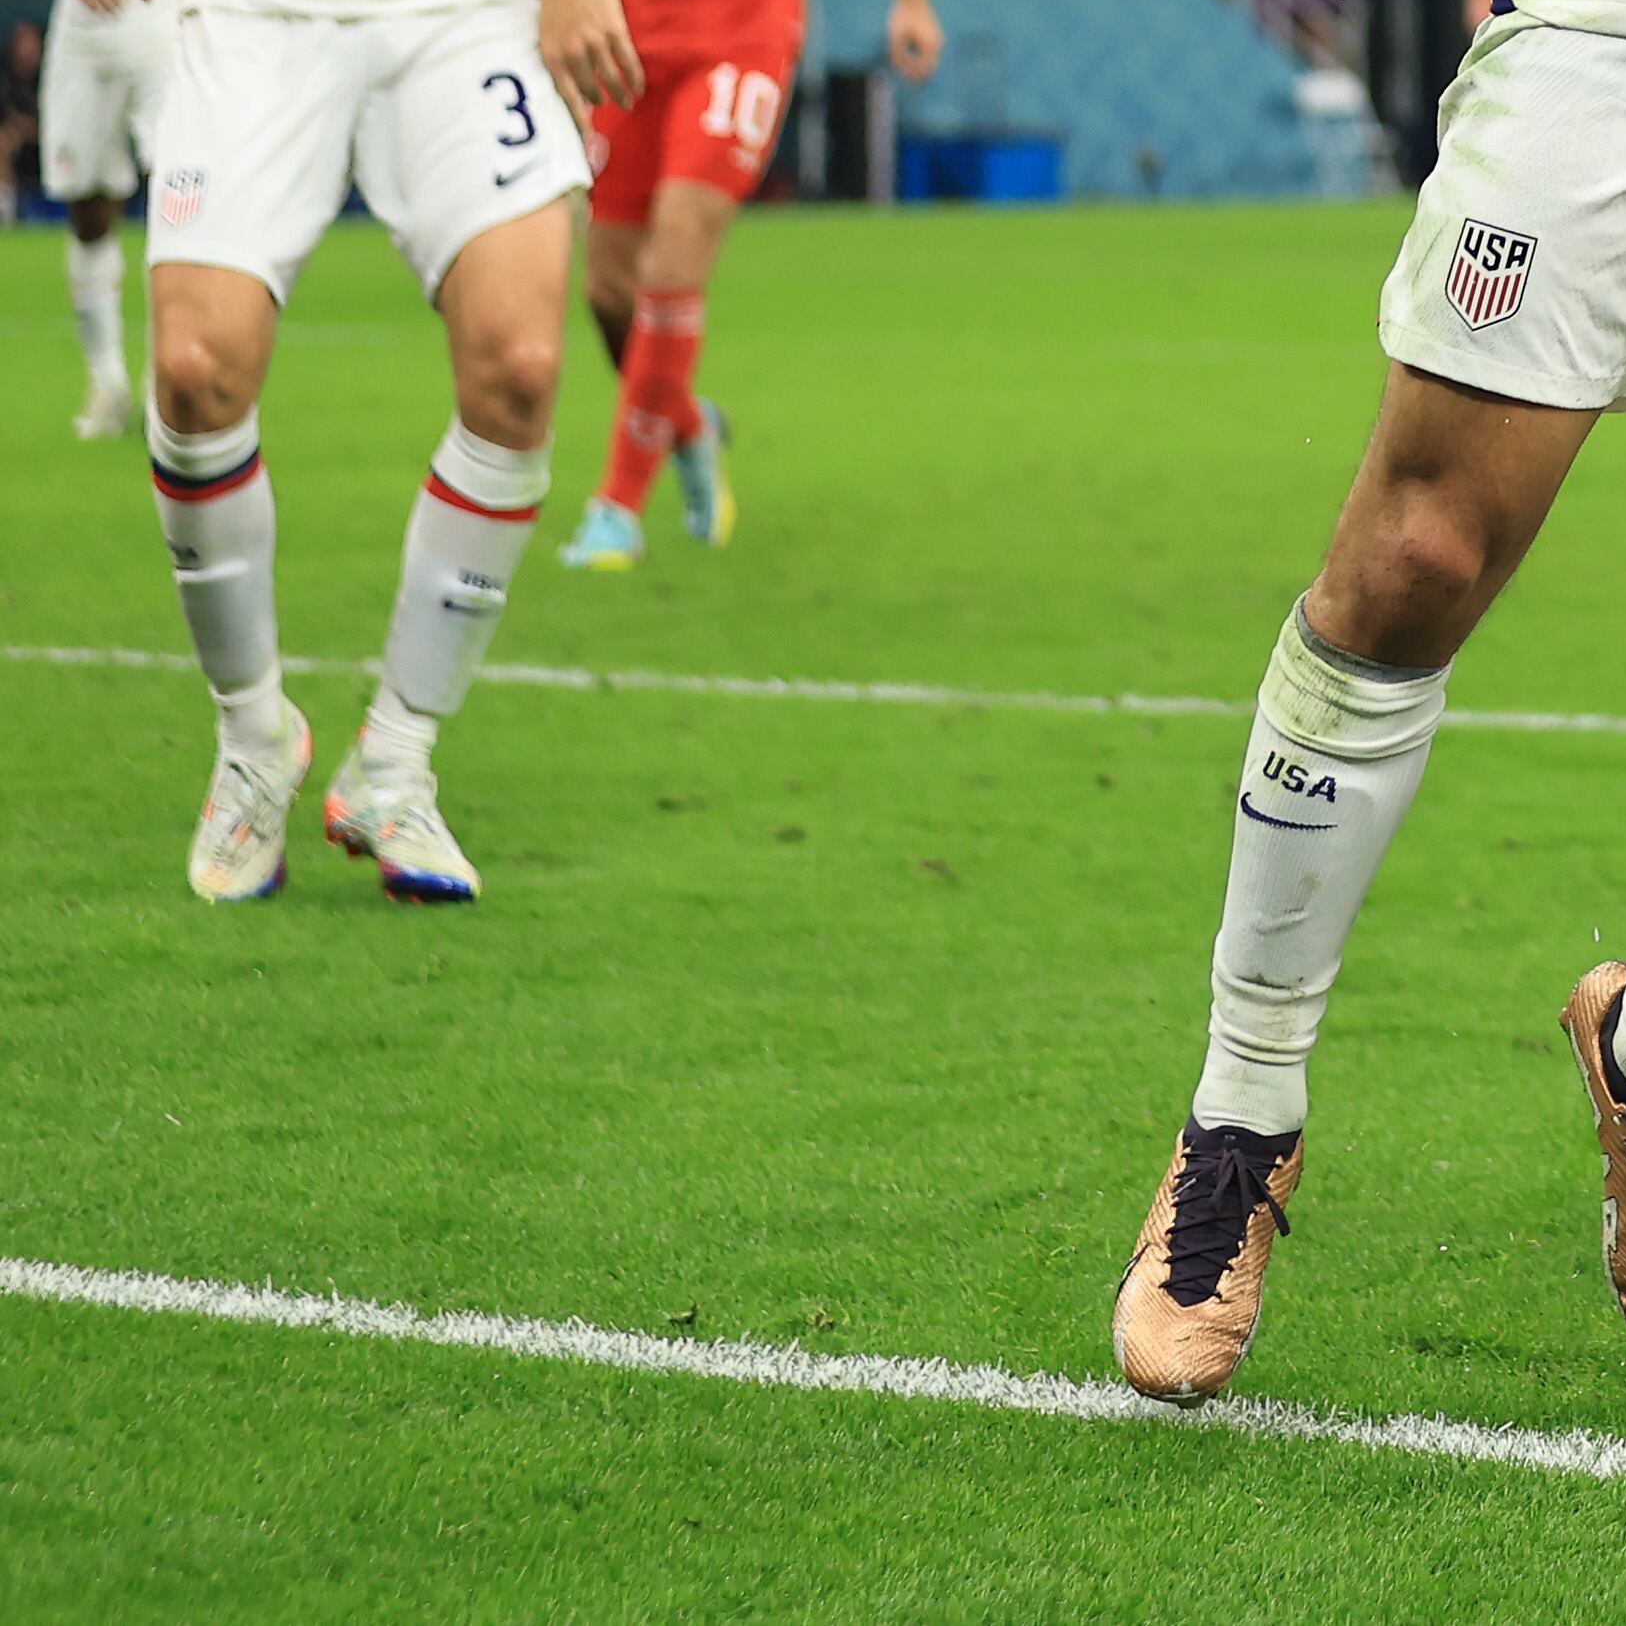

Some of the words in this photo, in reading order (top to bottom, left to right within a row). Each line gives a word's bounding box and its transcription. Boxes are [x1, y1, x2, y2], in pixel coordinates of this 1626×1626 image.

[483, 73, 535, 148] 3
[699, 61, 783, 152] 10
[1464, 226, 1530, 272] USA
[1263, 750, 1337, 804] USA
